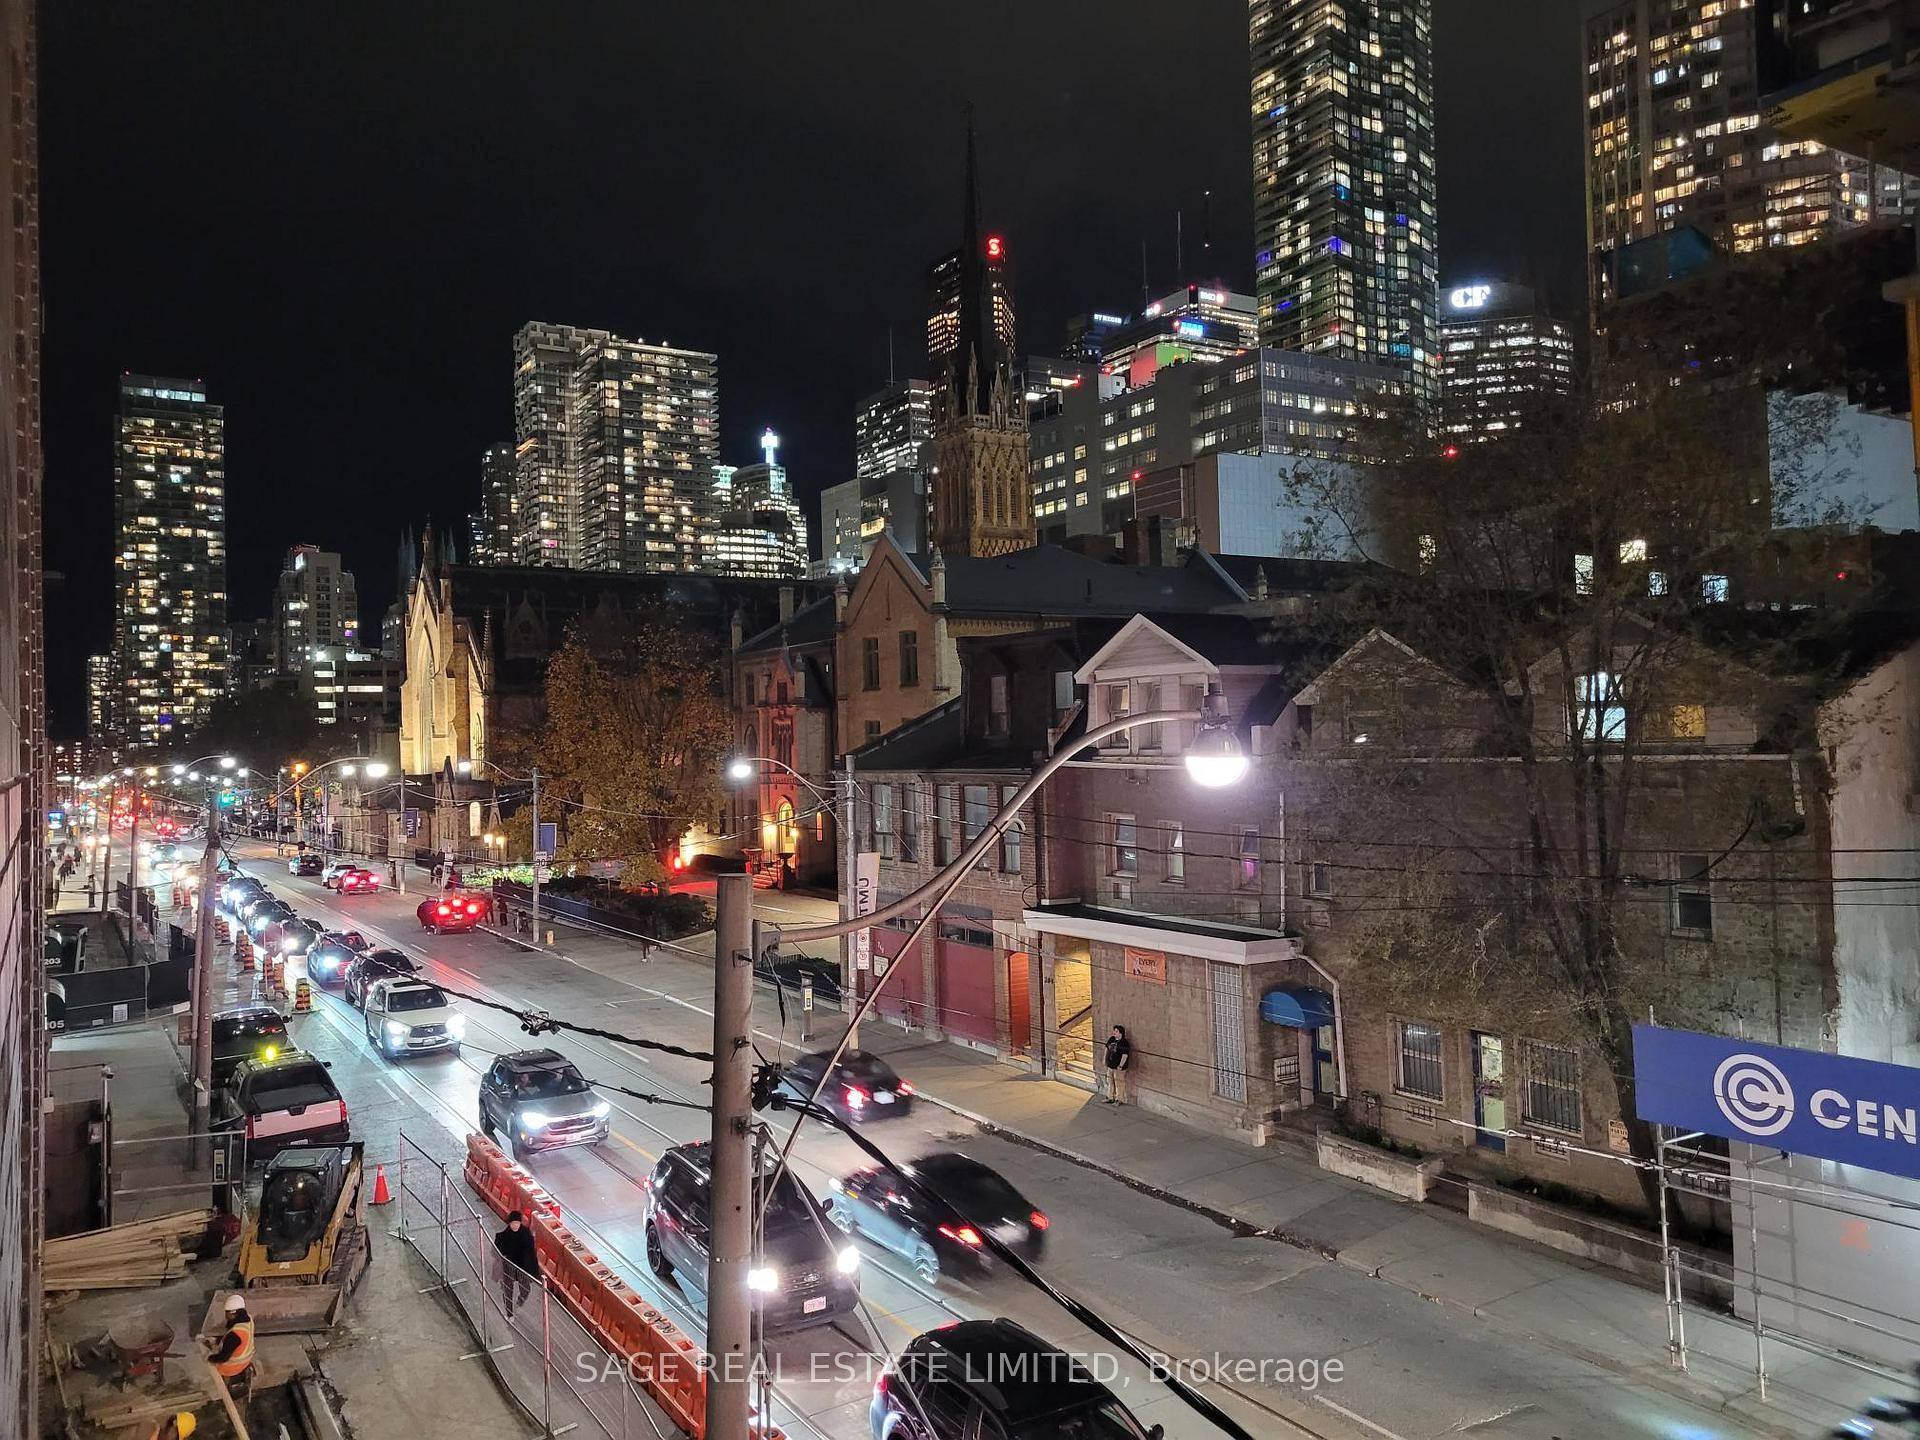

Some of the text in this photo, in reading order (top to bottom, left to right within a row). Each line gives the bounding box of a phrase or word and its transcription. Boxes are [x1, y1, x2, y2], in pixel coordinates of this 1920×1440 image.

[406, 818, 414, 836] TMU
[859, 877, 870, 916] TMU
[1809, 1088, 1918, 1145] CEN
